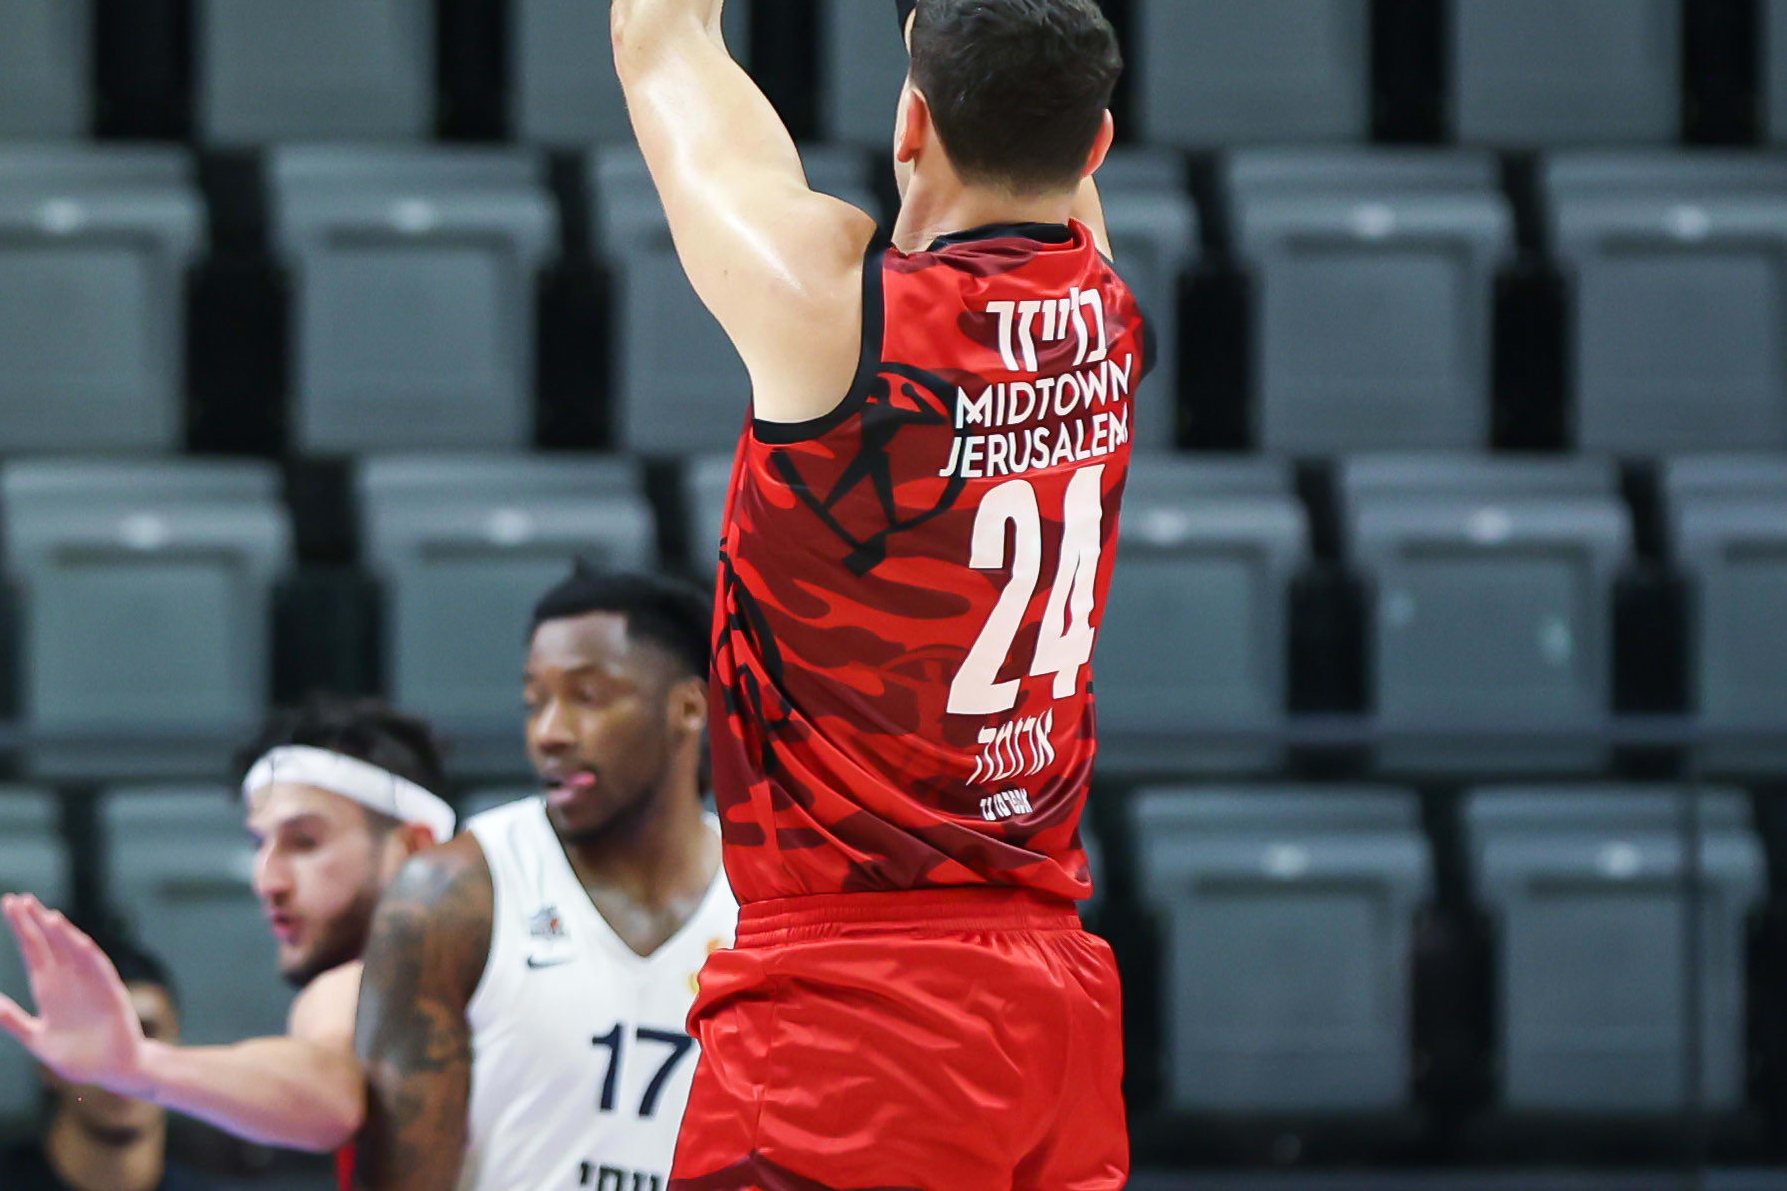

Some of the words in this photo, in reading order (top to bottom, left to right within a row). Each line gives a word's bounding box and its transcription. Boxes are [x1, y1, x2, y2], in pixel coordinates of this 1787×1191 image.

[955, 353, 1133, 429] MIDTOWN
[939, 402, 1129, 478] JERUSALEM
[946, 464, 1105, 714] 24
[966, 707, 1056, 785] ארומה
[591, 1022, 696, 1116] 17
